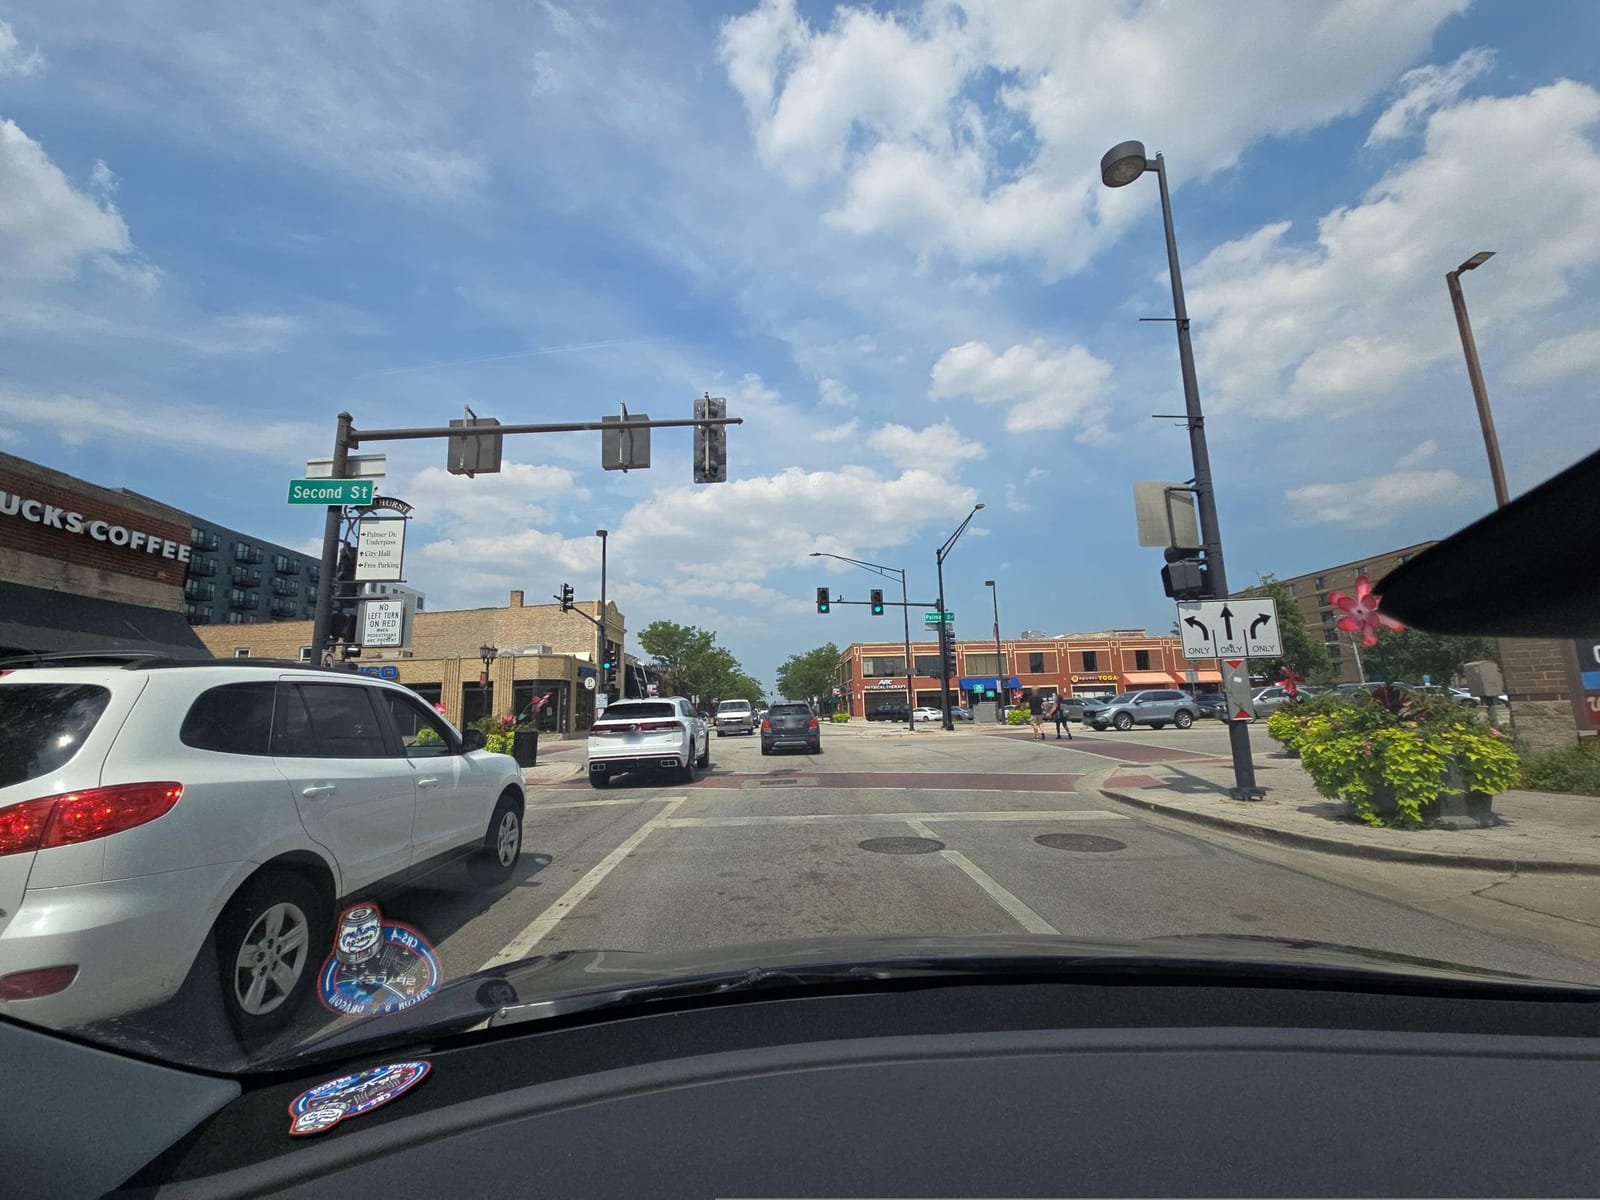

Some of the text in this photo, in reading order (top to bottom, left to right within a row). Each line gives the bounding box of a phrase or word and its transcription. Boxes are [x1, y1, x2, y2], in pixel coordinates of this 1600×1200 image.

[293, 485, 368, 499] Second St
[89, 520, 192, 563] COFFEE
[365, 550, 377, 558] City
[368, 611, 399, 620] LEFT TURN
[369, 620, 380, 628] ON
[1188, 647, 1210, 655] ONLY
[1220, 646, 1243, 654] ONLY
[1252, 644, 1275, 653] ONLY
